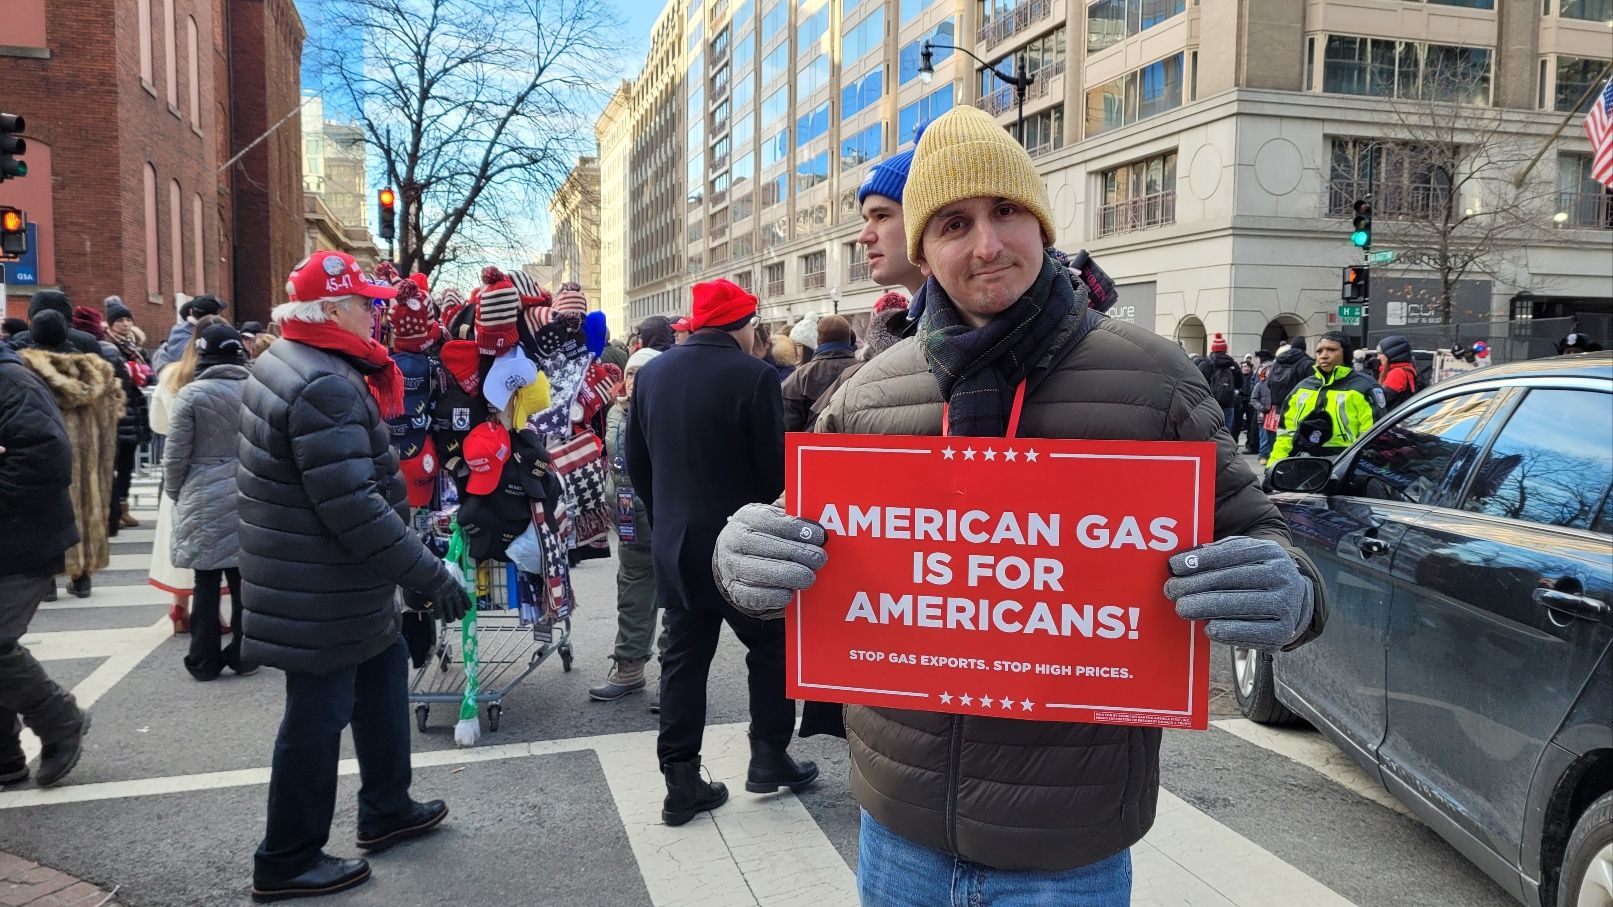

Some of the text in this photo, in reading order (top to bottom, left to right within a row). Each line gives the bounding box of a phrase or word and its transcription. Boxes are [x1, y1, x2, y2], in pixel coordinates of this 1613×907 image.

[326, 274, 353, 292] 45-47
[1109, 305, 1135, 319] cure
[1343, 307, 1350, 316] H
[496, 338, 504, 348] 47
[819, 503, 1179, 552] AMERICAN GAS
[914, 552, 1065, 592] IS FOR
[845, 591, 1140, 639] AMERICANS!
[849, 649, 1134, 679] STOP GAS EXPORTS. STOP HIGH PRICES.
